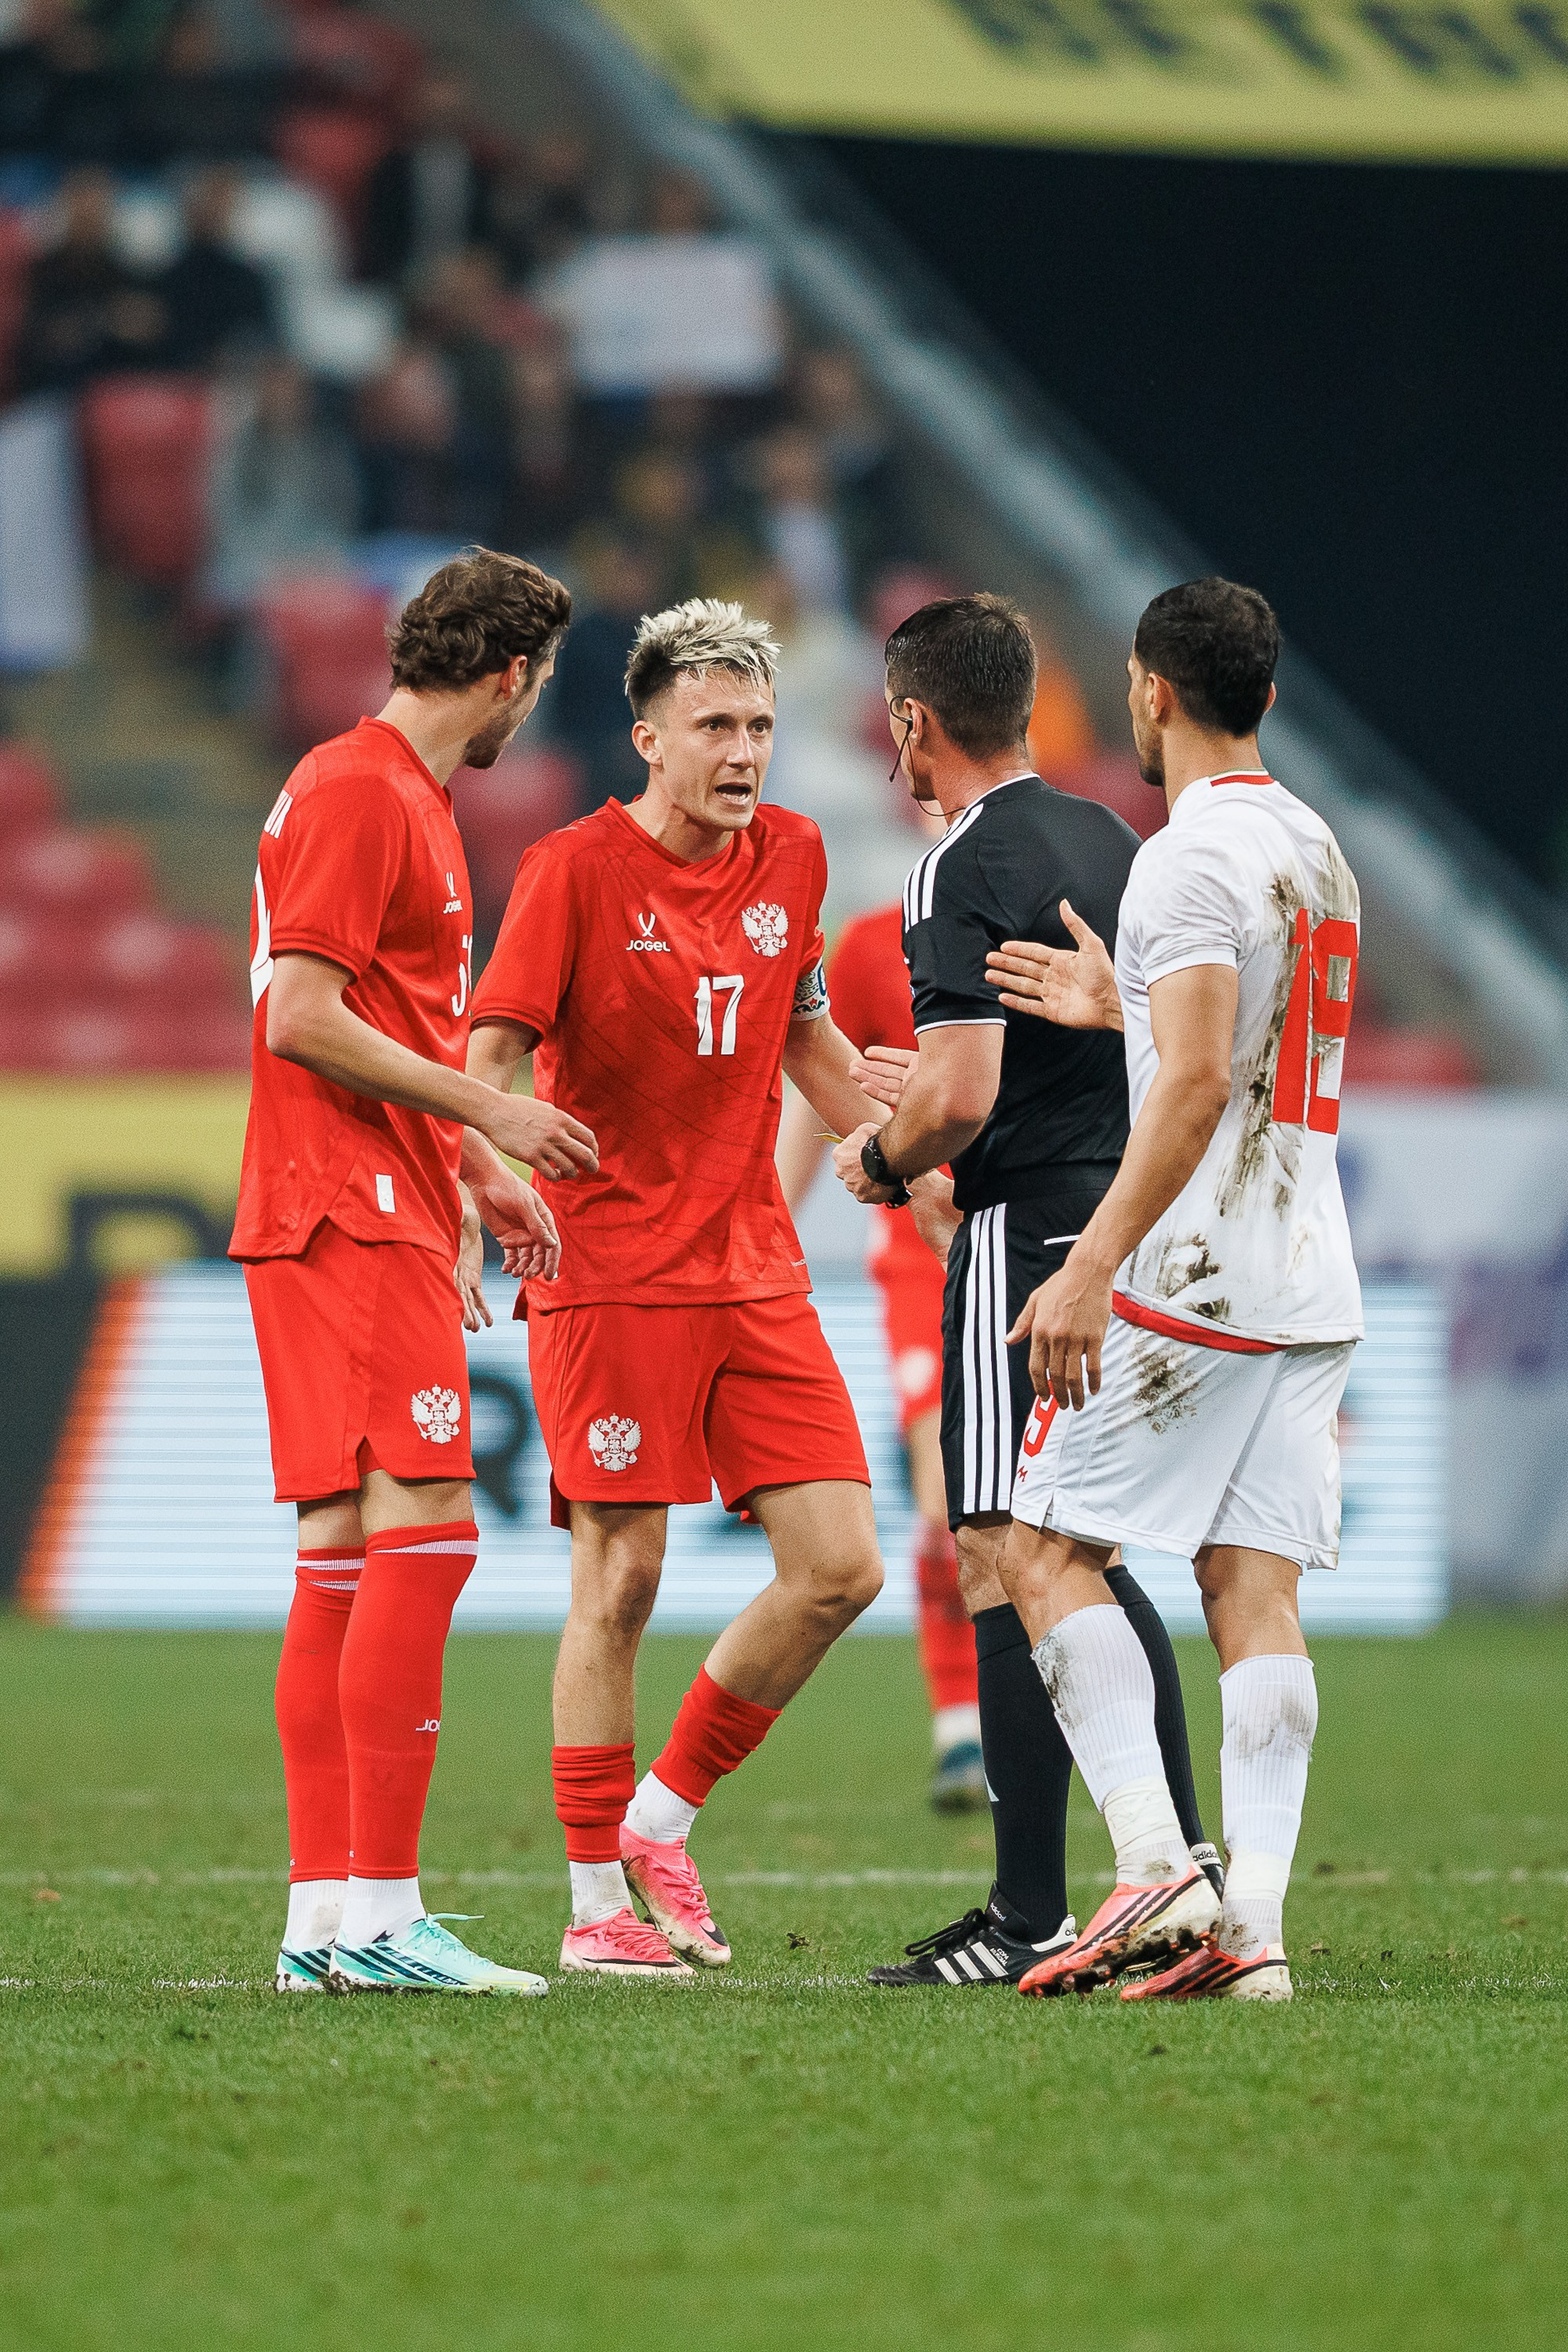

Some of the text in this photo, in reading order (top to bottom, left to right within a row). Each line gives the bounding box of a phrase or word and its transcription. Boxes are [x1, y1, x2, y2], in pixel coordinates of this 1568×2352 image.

[693, 975, 745, 1056] 17
[1272, 907, 1359, 1135] 19
[1192, 1849, 1219, 1862] adida
